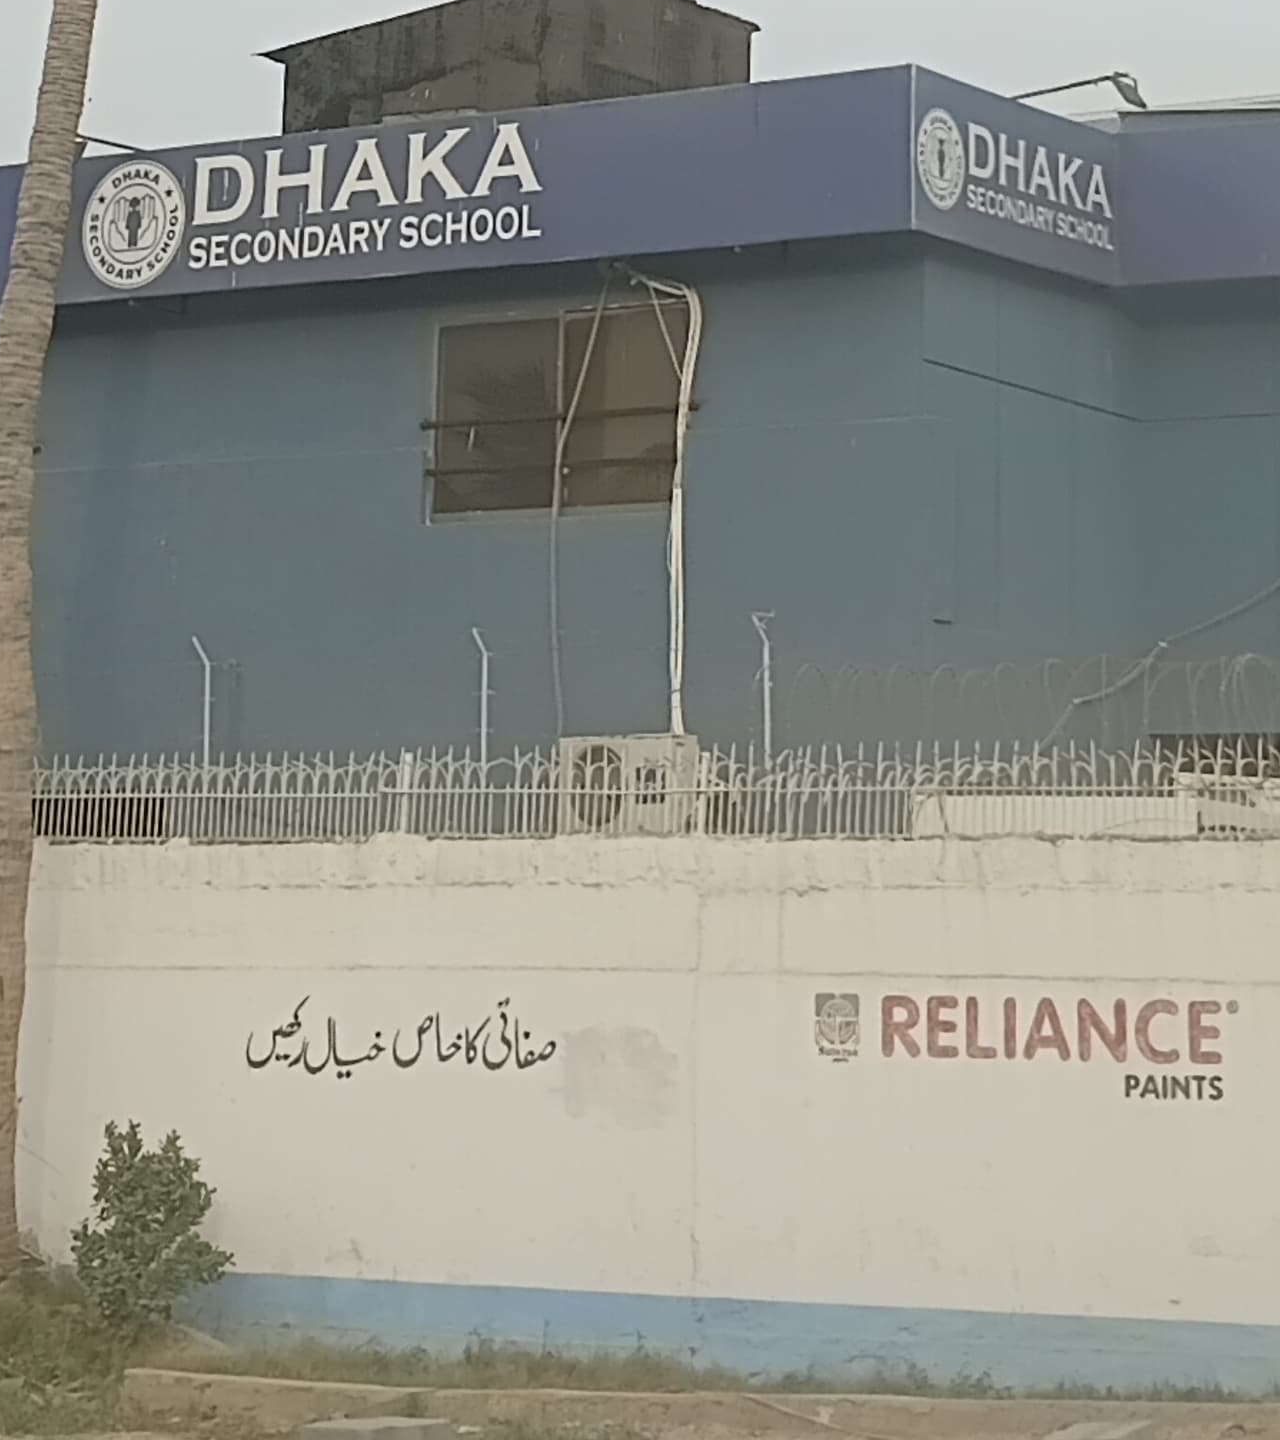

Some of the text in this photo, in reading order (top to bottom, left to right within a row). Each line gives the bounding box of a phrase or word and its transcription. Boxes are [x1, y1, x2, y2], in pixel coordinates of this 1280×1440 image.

[112, 169, 160, 188] DHAKA
[191, 122, 543, 226] DHAKA
[968, 122, 1112, 219] DHAKA
[188, 205, 541, 270] SECONDARY SCHOOL
[967, 184, 1114, 251] SECONDARY SCHOOL
[246, 995, 556, 1079] صفائی کا خاص خیال رکھیں
[881, 995, 1223, 1065] RELIANCE
[1124, 1074, 1224, 1100] PAINTS
